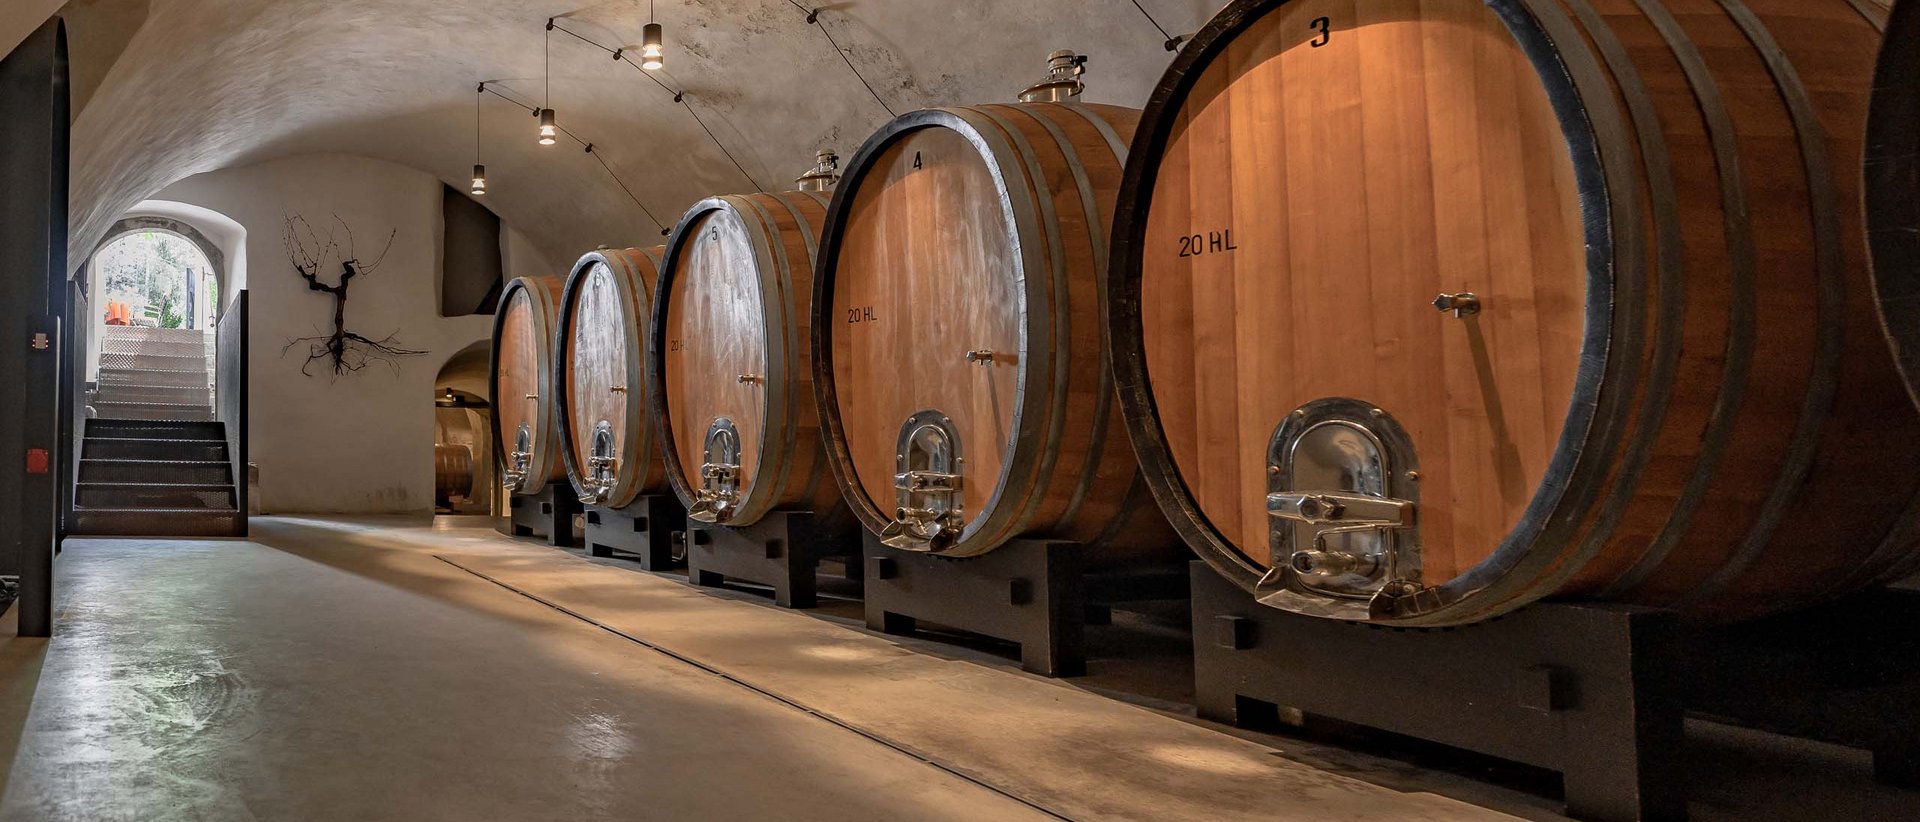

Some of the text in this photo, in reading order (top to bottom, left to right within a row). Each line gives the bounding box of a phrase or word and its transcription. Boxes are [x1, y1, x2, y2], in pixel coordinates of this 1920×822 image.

[1310, 16, 1329, 48] 3
[913, 150, 922, 170] 4
[711, 226, 718, 241] 5
[1179, 229, 1238, 258] 20 HL
[848, 306, 878, 323] 20 HL
[671, 340, 679, 352] 20
